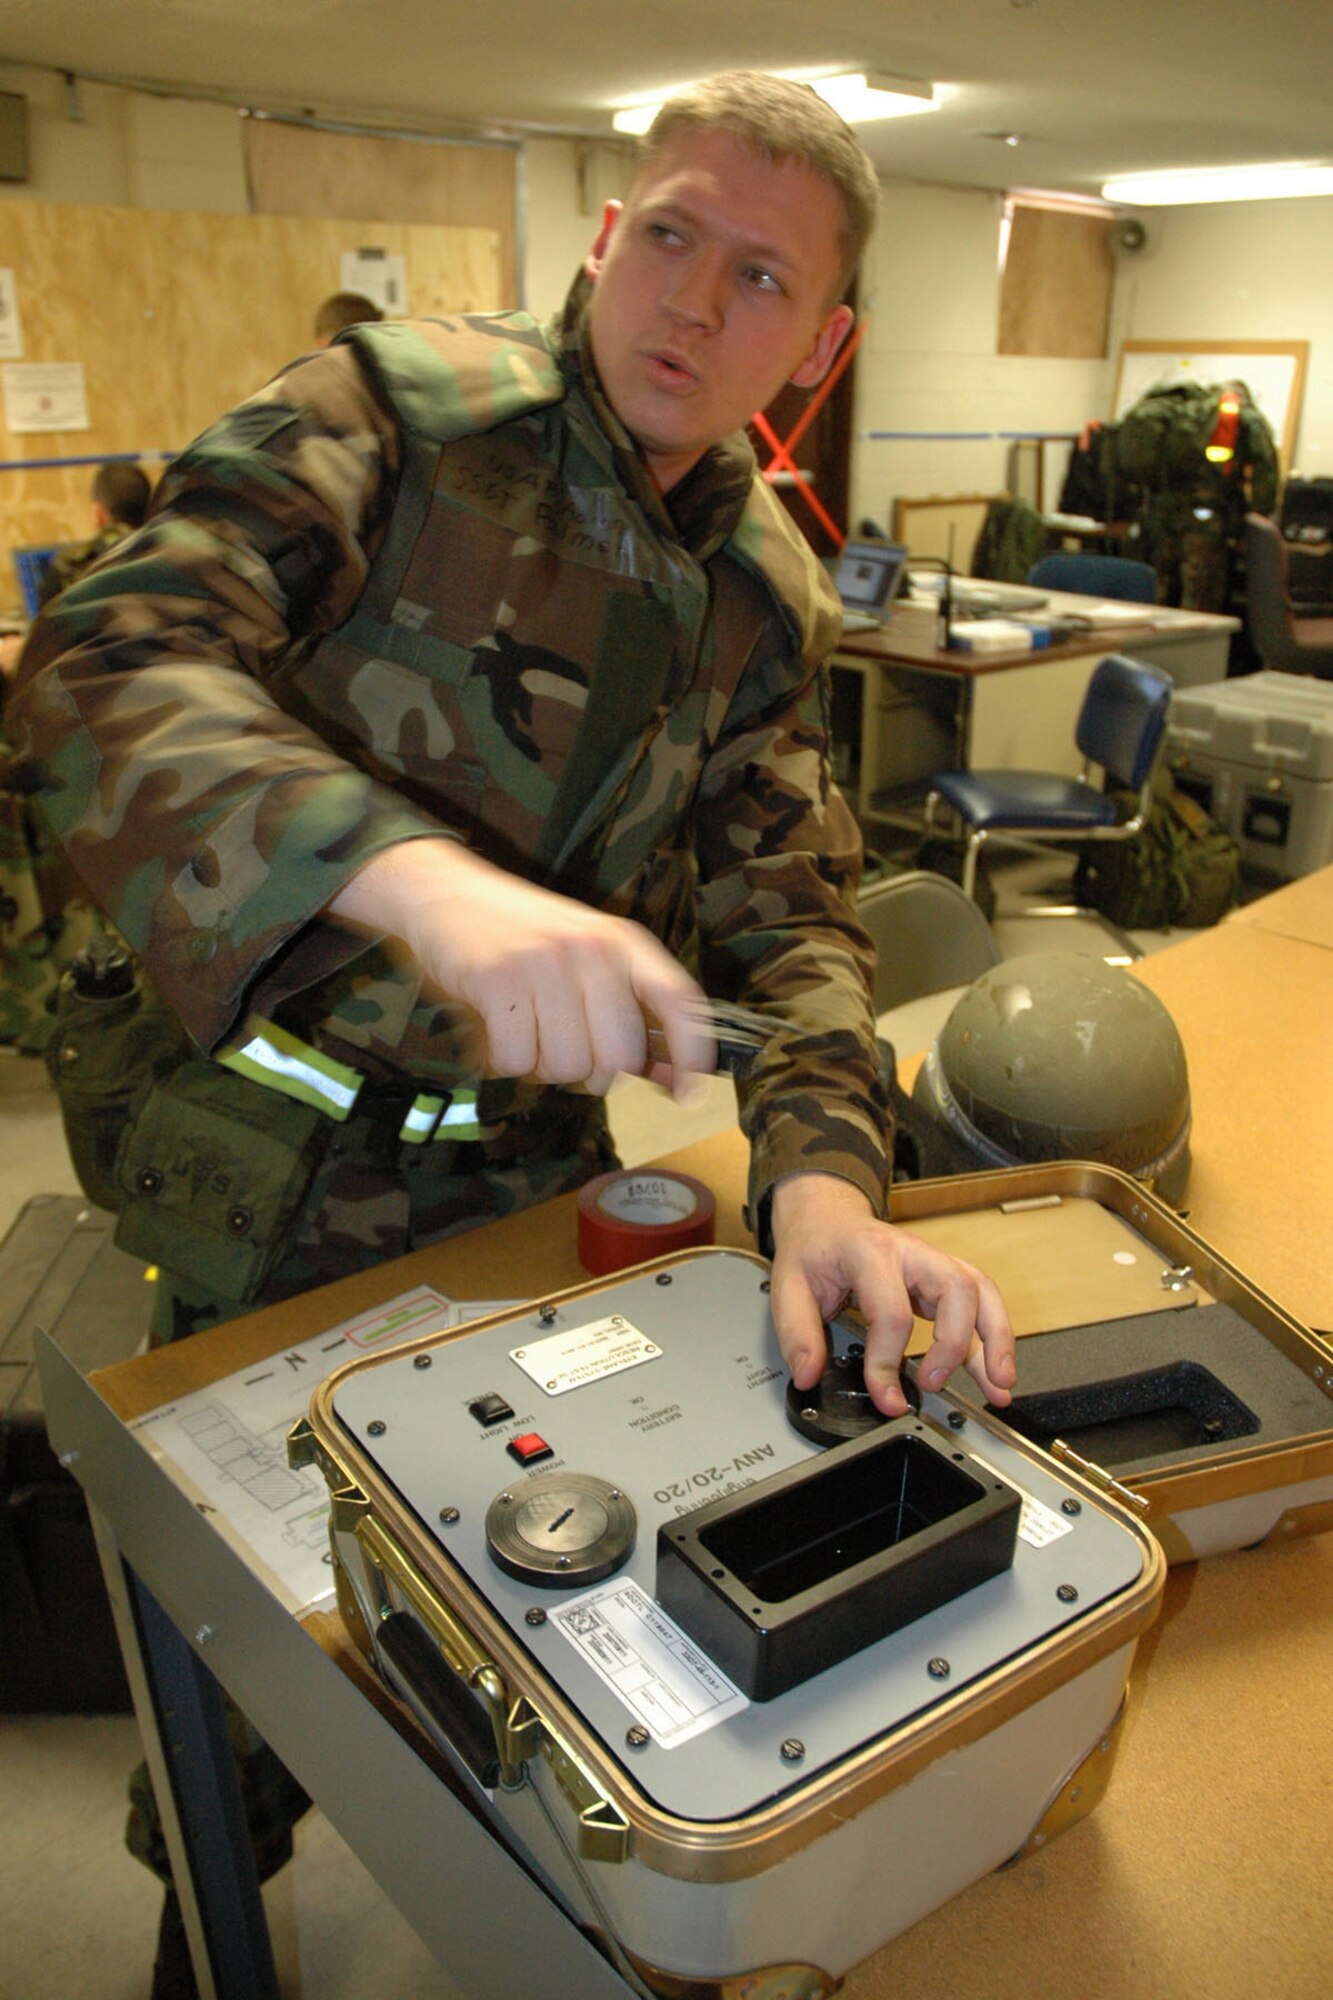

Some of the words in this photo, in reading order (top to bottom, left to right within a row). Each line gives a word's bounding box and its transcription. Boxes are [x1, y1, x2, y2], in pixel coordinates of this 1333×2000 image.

[746, 1366, 773, 1382] LIGHT
[513, 1414, 536, 1428] LOW
[628, 1404, 680, 1429] CONDITION
[641, 1412, 683, 1433] BATTERY
[479, 1424, 510, 1440] LIGHT
[527, 1458, 566, 1478] POWER
[653, 1443, 775, 1504] ANV-20/20
